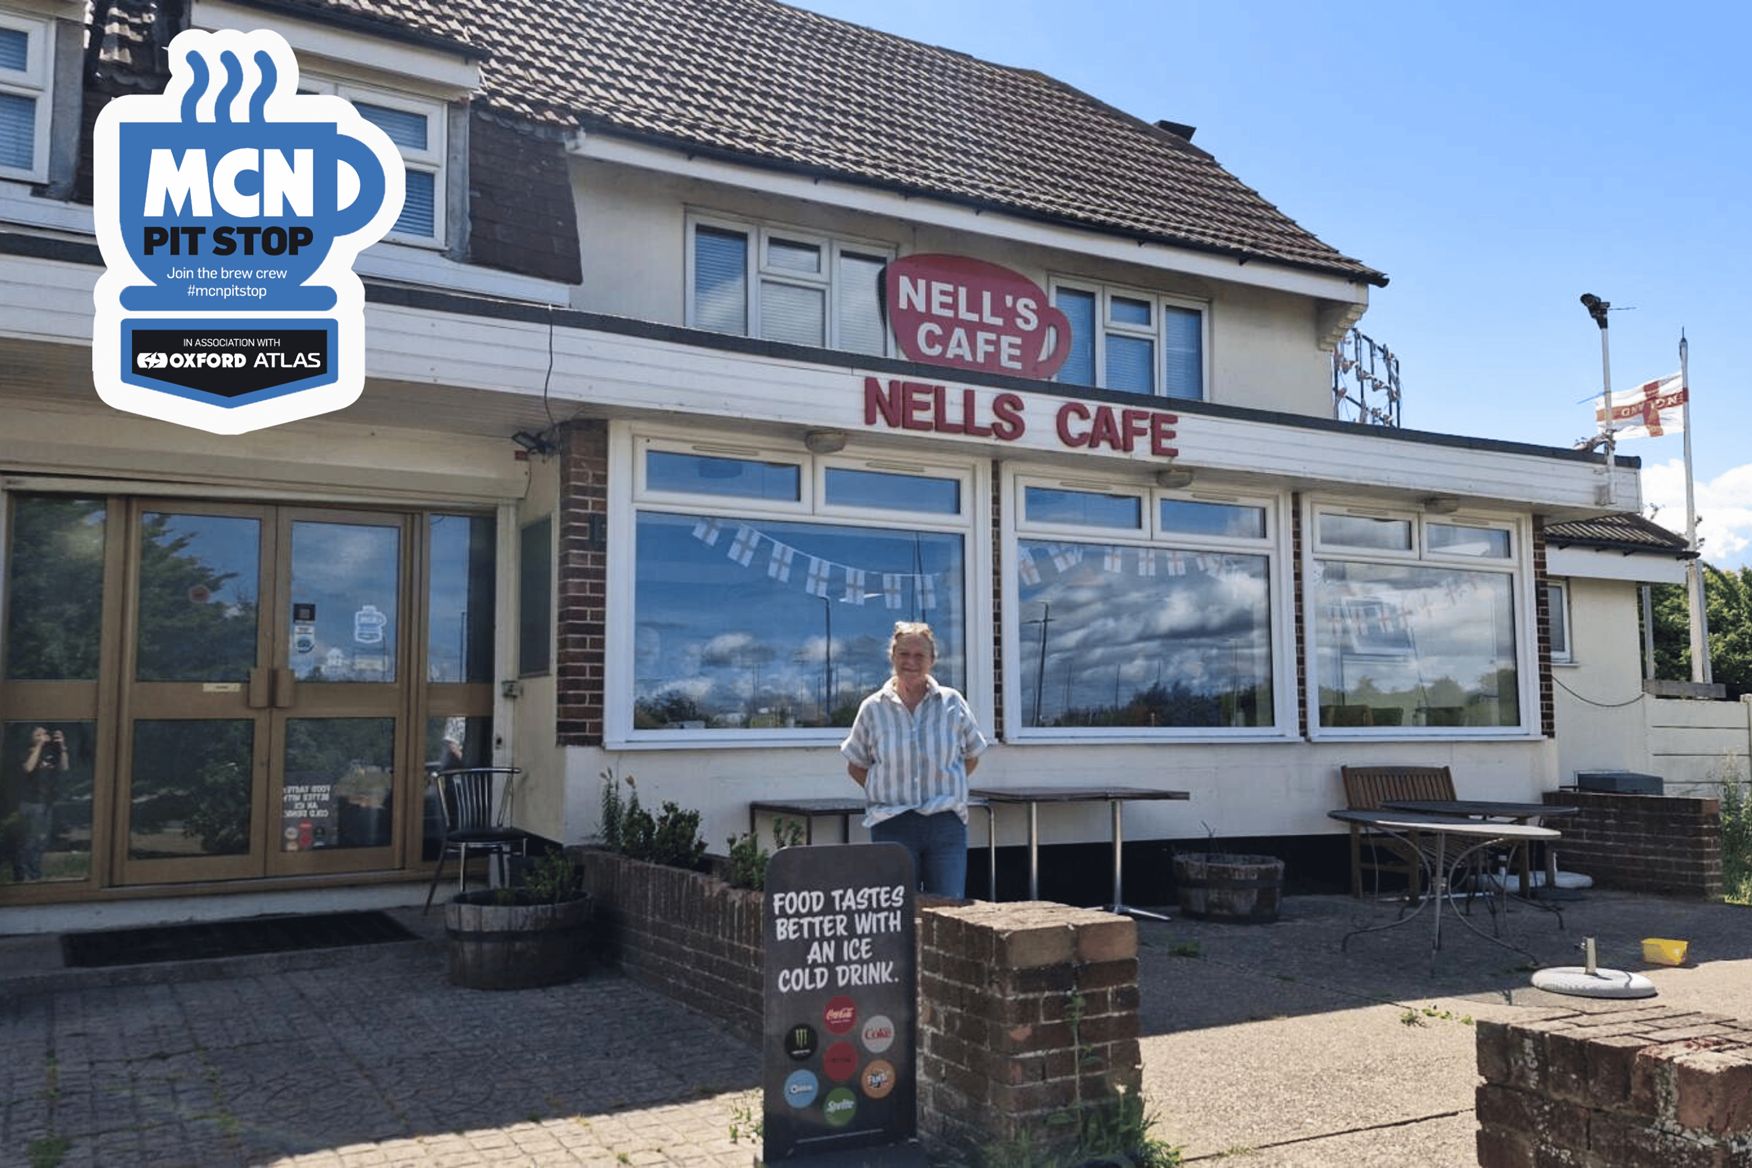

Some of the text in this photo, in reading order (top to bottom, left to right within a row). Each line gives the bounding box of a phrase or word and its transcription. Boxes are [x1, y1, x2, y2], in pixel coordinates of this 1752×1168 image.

[898, 275, 1039, 331] NELL'S
[916, 321, 1023, 370] CAFE
[864, 376, 1179, 457] NELLS CAFE
[773, 885, 905, 915] FOOD TASTES
[775, 910, 902, 941] BETTER WITH
[807, 938, 873, 964] AN ICE
[778, 961, 899, 993] COLD DRINK.
